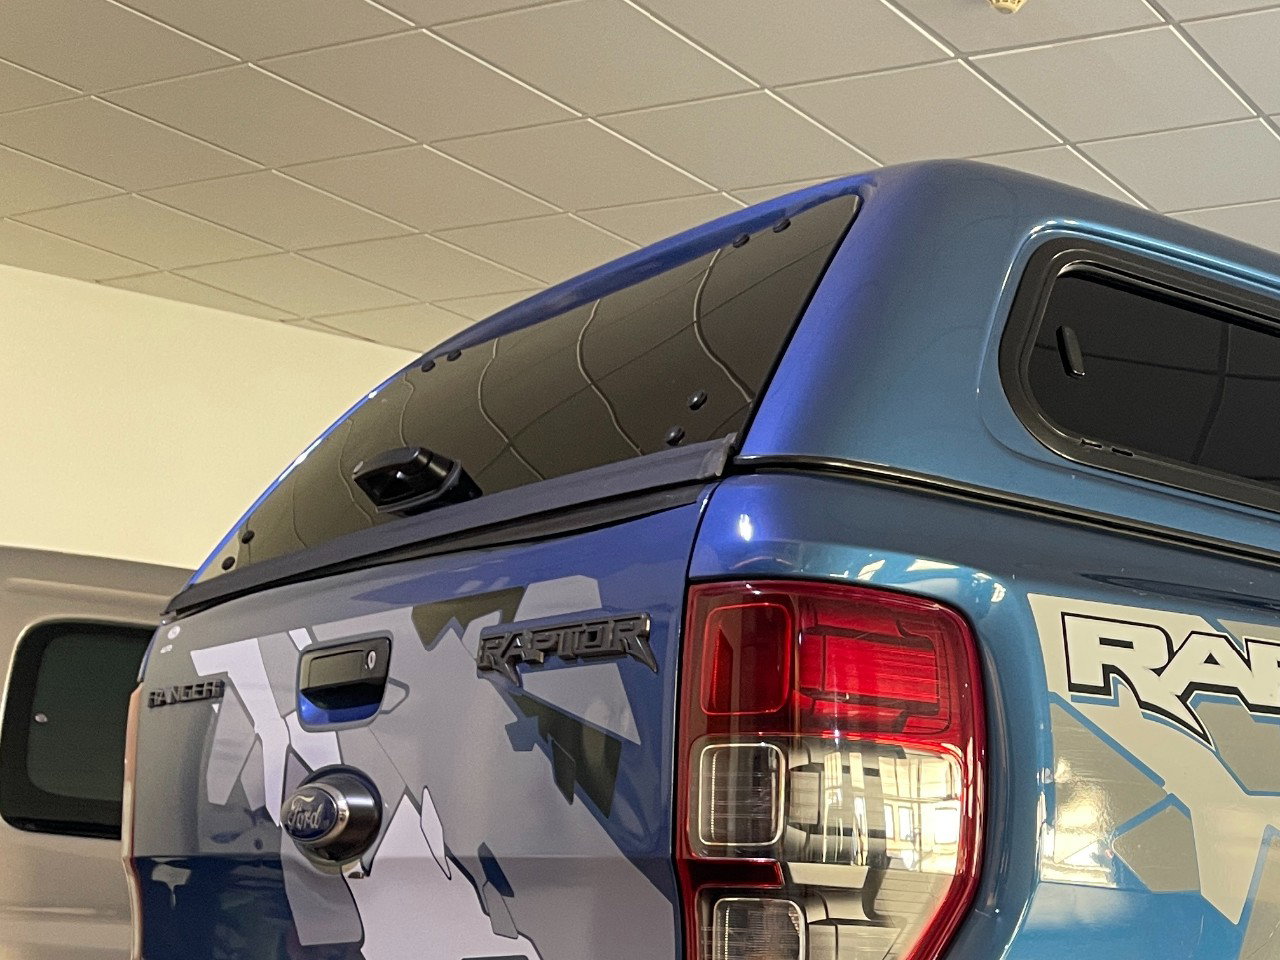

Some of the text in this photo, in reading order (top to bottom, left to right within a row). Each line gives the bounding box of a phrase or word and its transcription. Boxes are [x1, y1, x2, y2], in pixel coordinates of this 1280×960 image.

[477, 612, 657, 686] RAPTOR
[148, 680, 225, 708] RANGER
[287, 794, 326, 831] Ford
